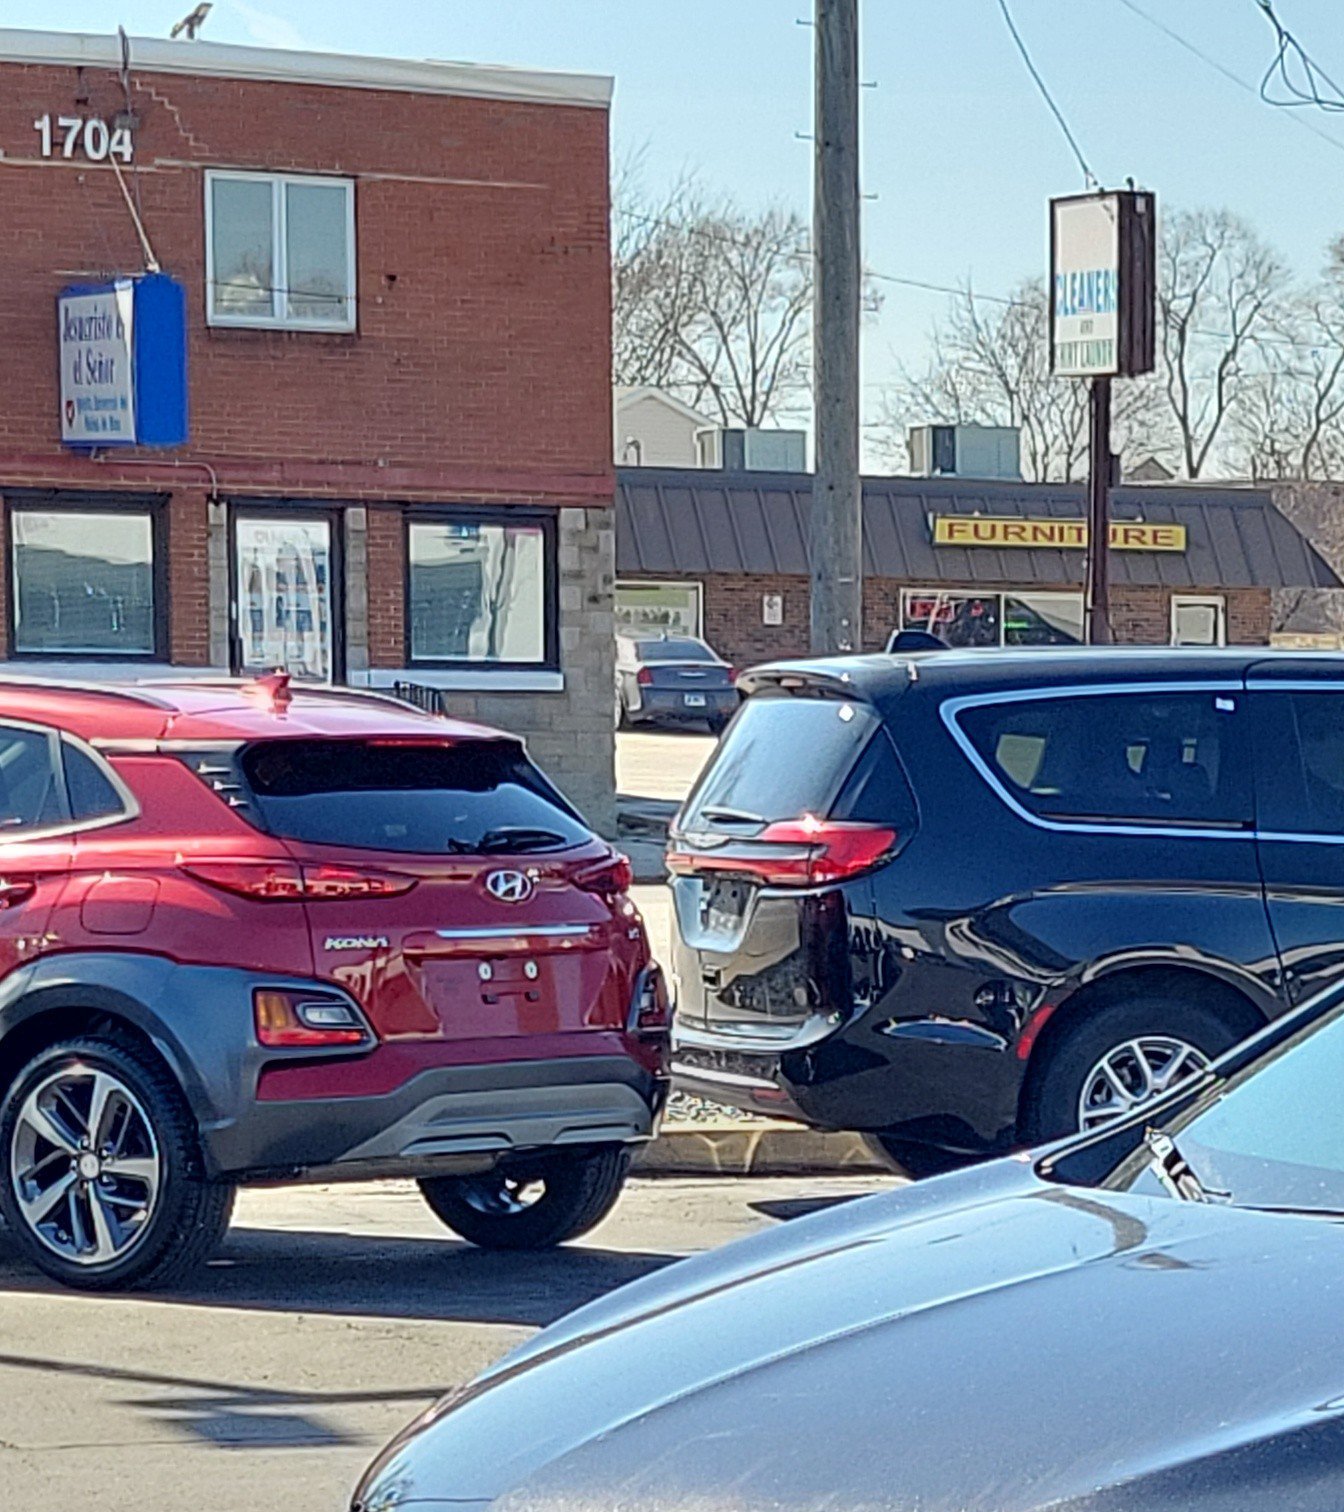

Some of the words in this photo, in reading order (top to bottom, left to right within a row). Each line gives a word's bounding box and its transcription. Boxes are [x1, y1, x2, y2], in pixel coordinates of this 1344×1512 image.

[34, 113, 133, 162] 1704
[63, 305, 113, 342] Jesucristo
[324, 936, 389, 950] KONA
